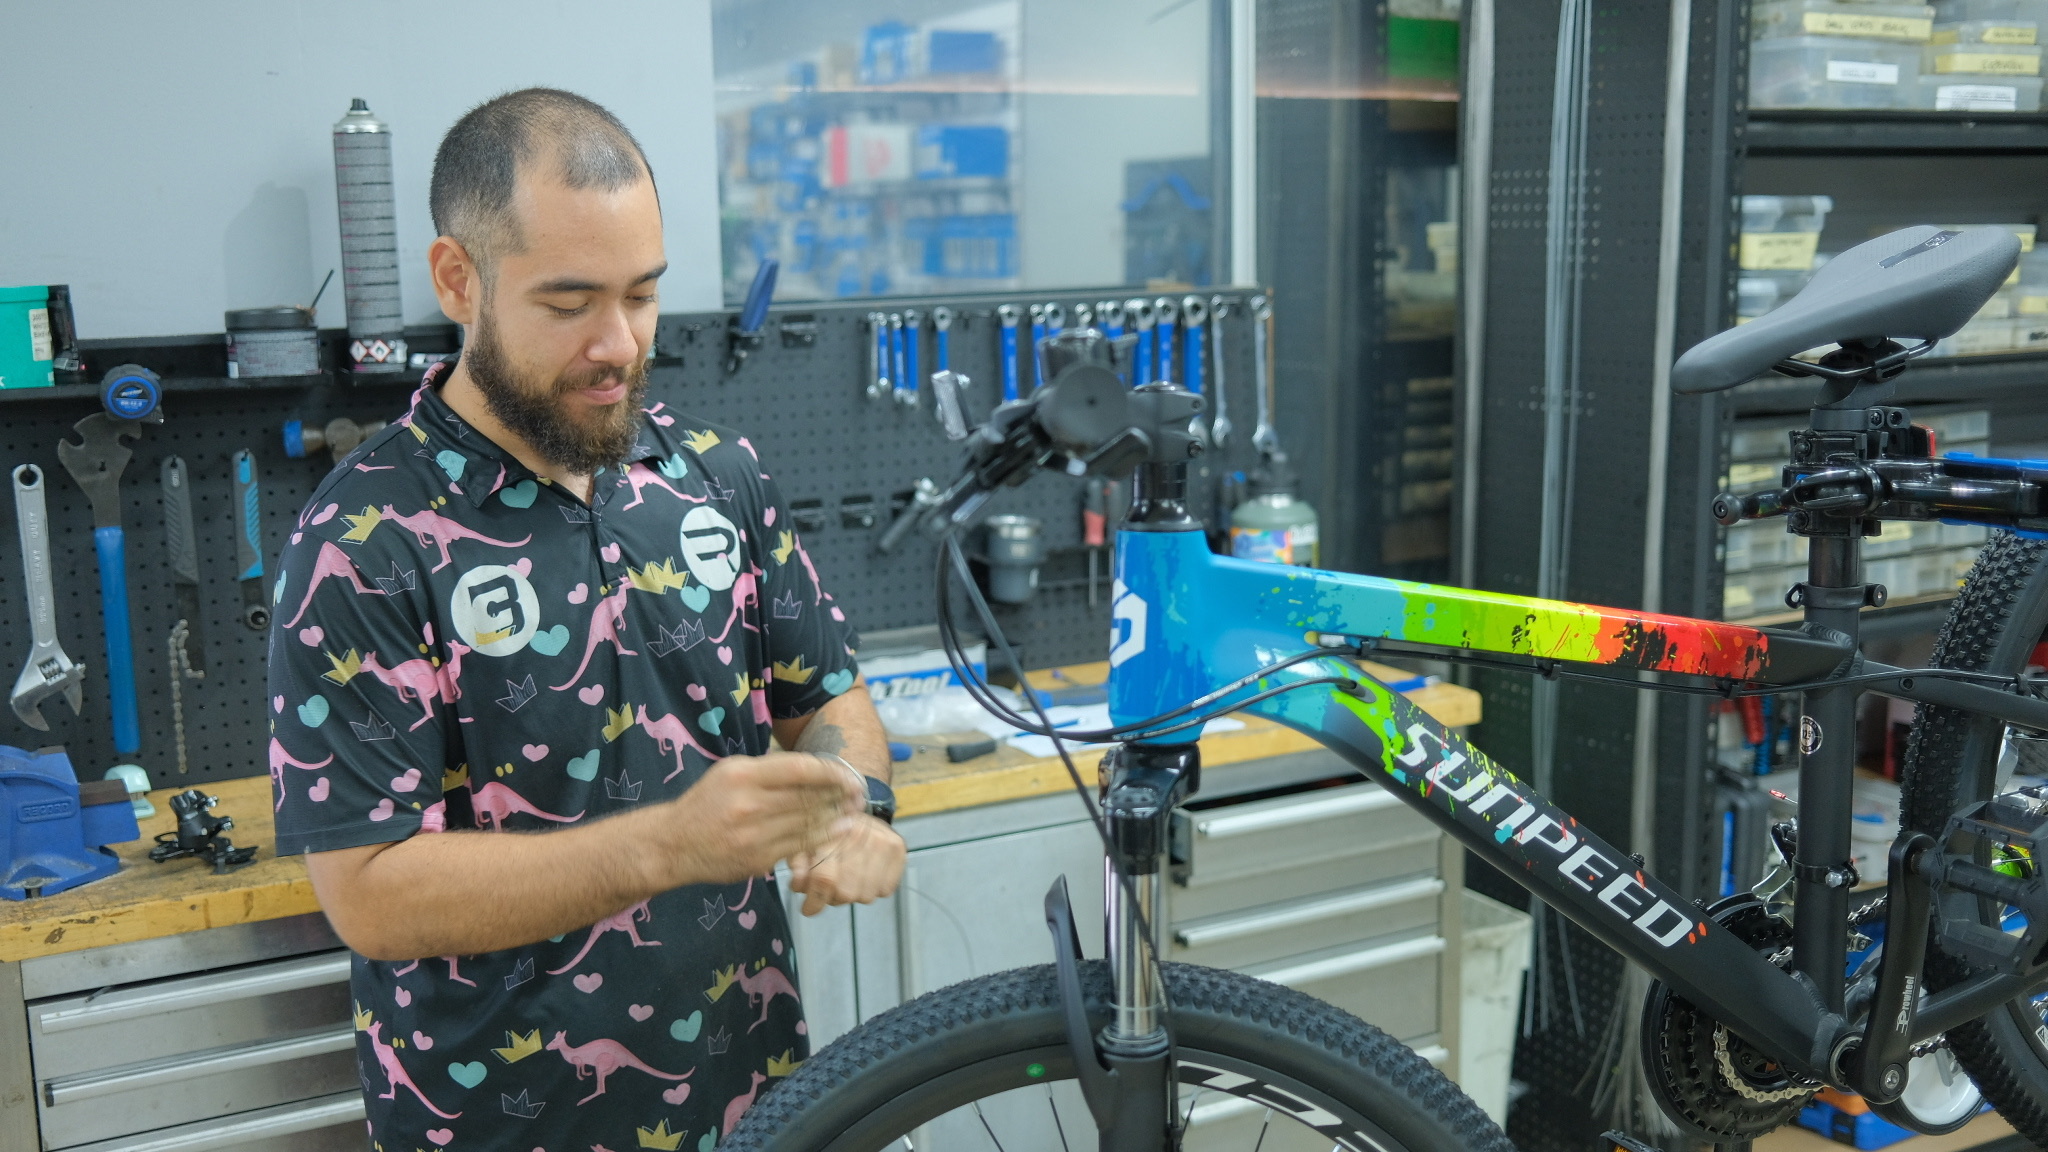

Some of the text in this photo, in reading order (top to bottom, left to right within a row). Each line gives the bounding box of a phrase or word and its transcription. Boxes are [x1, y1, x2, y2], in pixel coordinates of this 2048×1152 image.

[24, 802, 69, 817] RECORD
[1396, 722, 1694, 948] SUNPEED
[1895, 975, 1915, 1036] Prowheel
